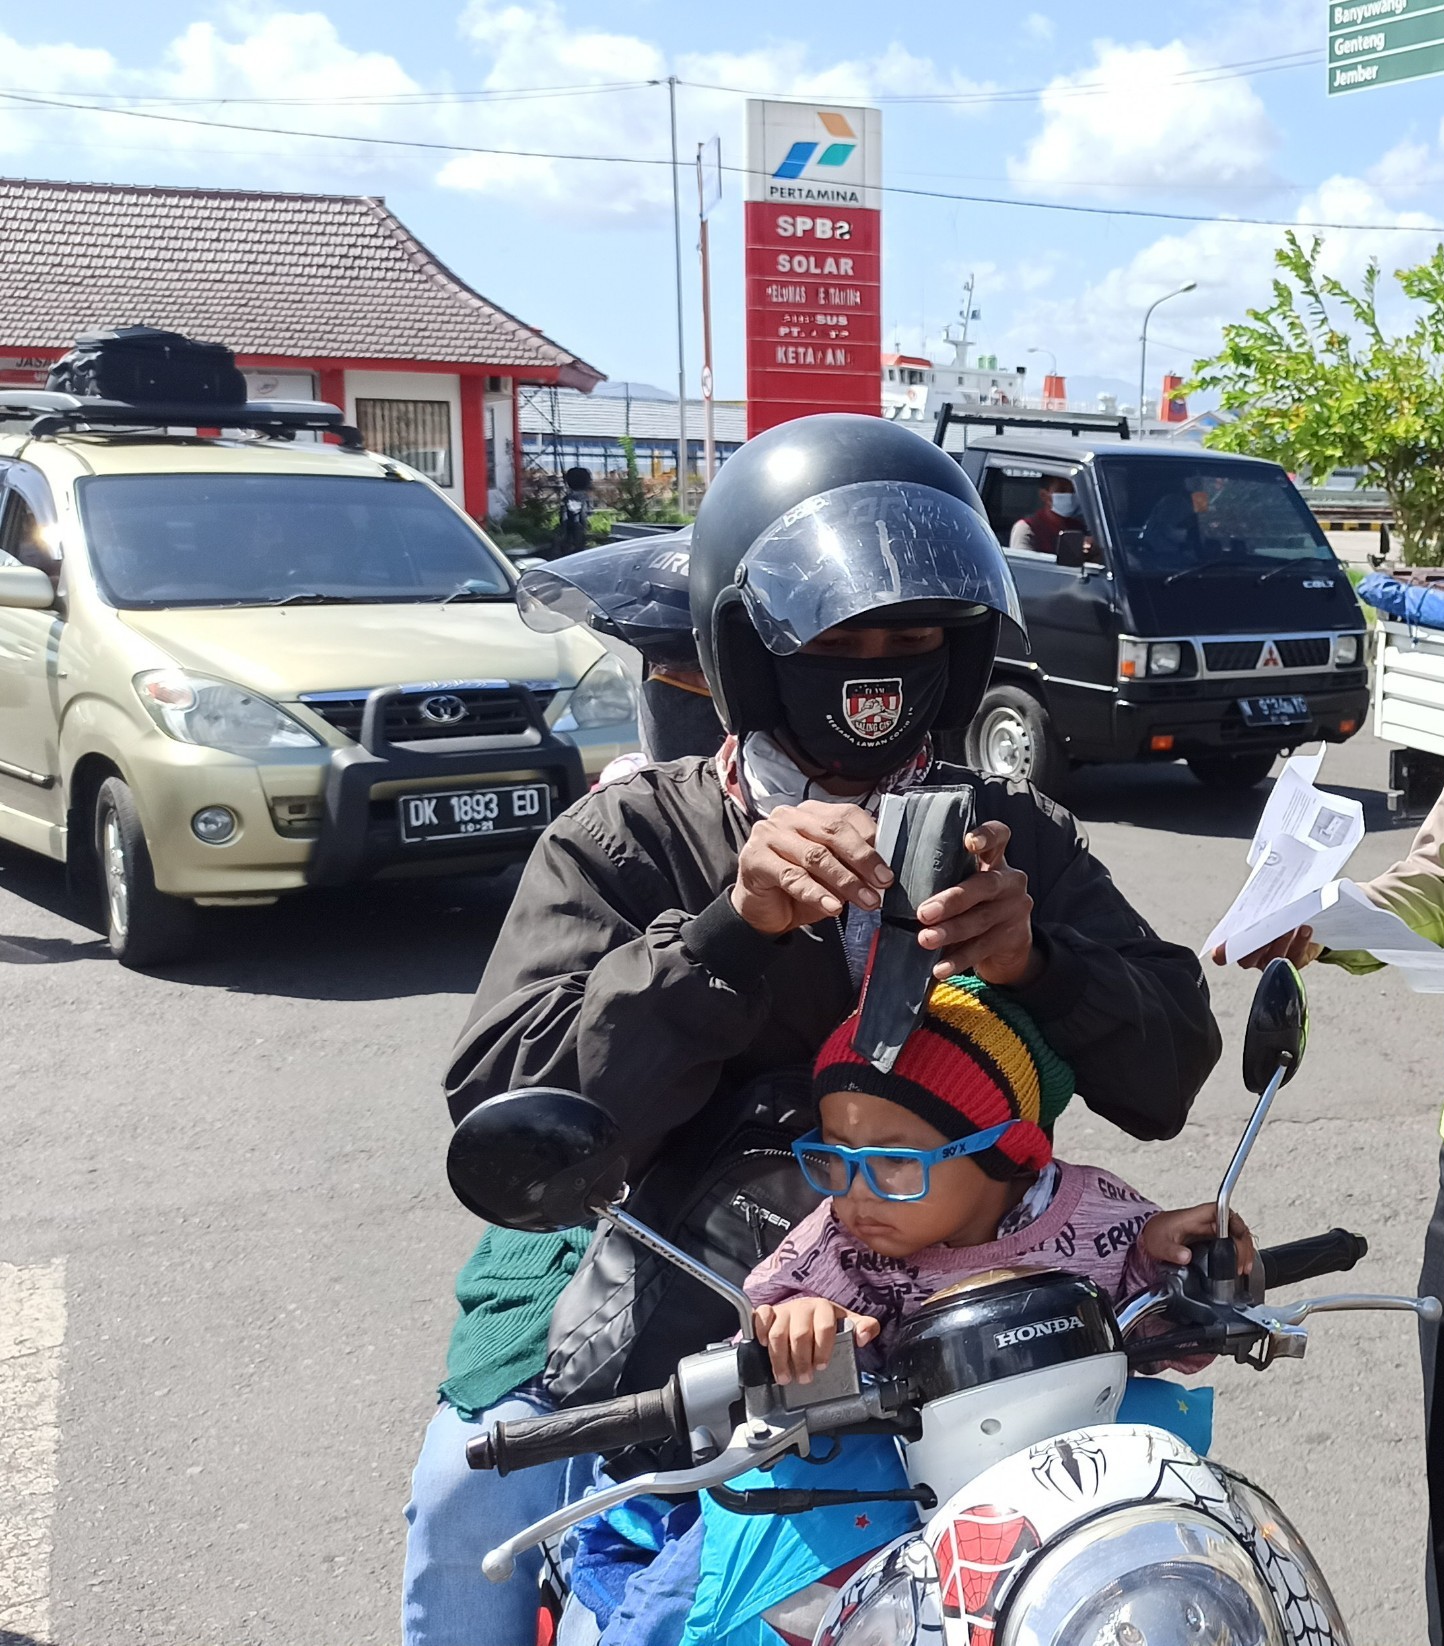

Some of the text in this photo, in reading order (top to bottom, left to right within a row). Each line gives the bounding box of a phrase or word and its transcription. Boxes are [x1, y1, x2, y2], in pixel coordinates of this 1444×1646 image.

[1334, 32, 1385, 56] Genteng
[1333, 64, 1379, 87] Jember
[769, 185, 859, 203] PERTAMINA
[776, 253, 855, 276] SOLAR
[856, 738, 889, 748] LAWAN
[409, 789, 540, 828] DK 1893 ED
[995, 1315, 1085, 1349] HONDA
